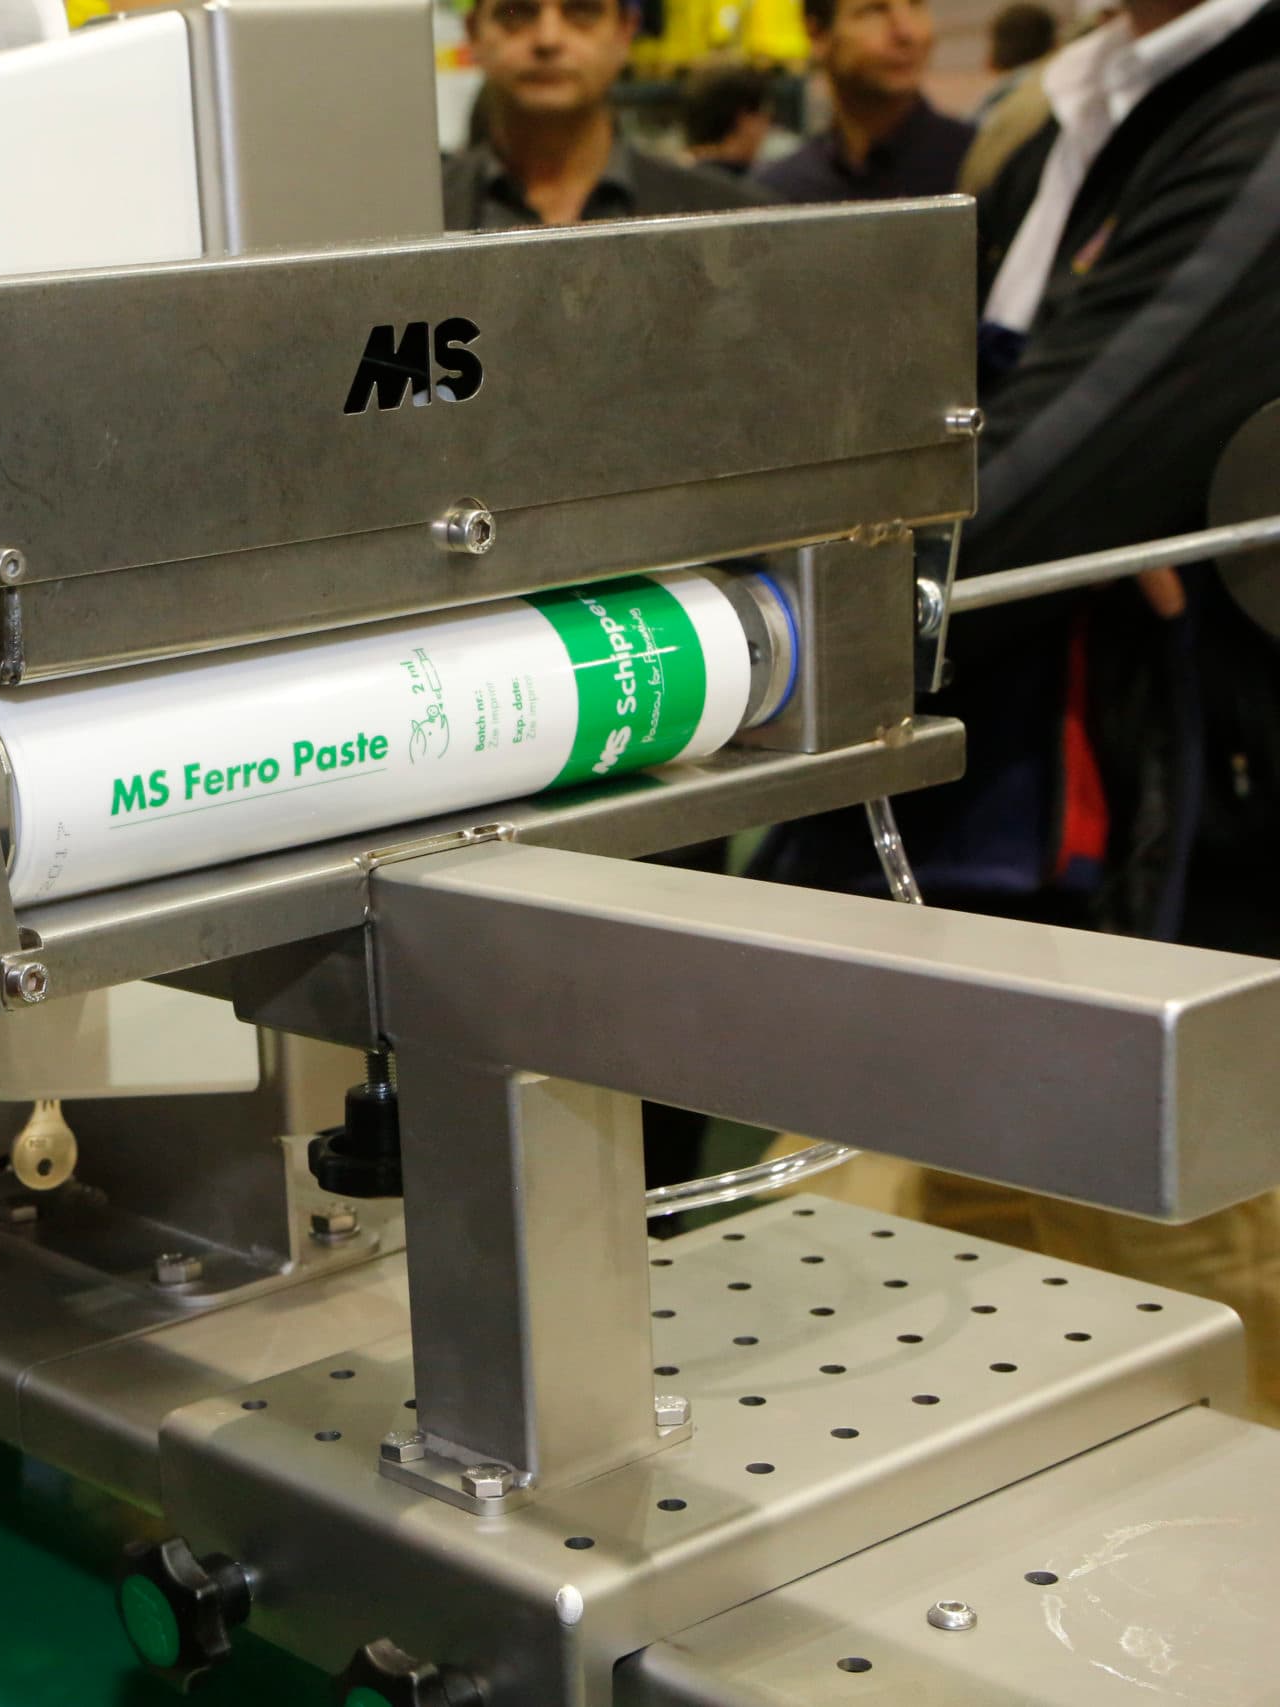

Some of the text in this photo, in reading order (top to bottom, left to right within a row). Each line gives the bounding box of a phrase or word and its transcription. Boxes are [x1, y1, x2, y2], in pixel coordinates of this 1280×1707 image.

[343, 317, 484, 416] MS
[400, 661, 426, 695] 2 ml
[647, 666, 662, 686] for
[475, 715, 487, 752] Batch
[512, 715, 526, 744] Exp.
[592, 725, 632, 775] MS
[110, 732, 389, 816] MS Ferro Paste
